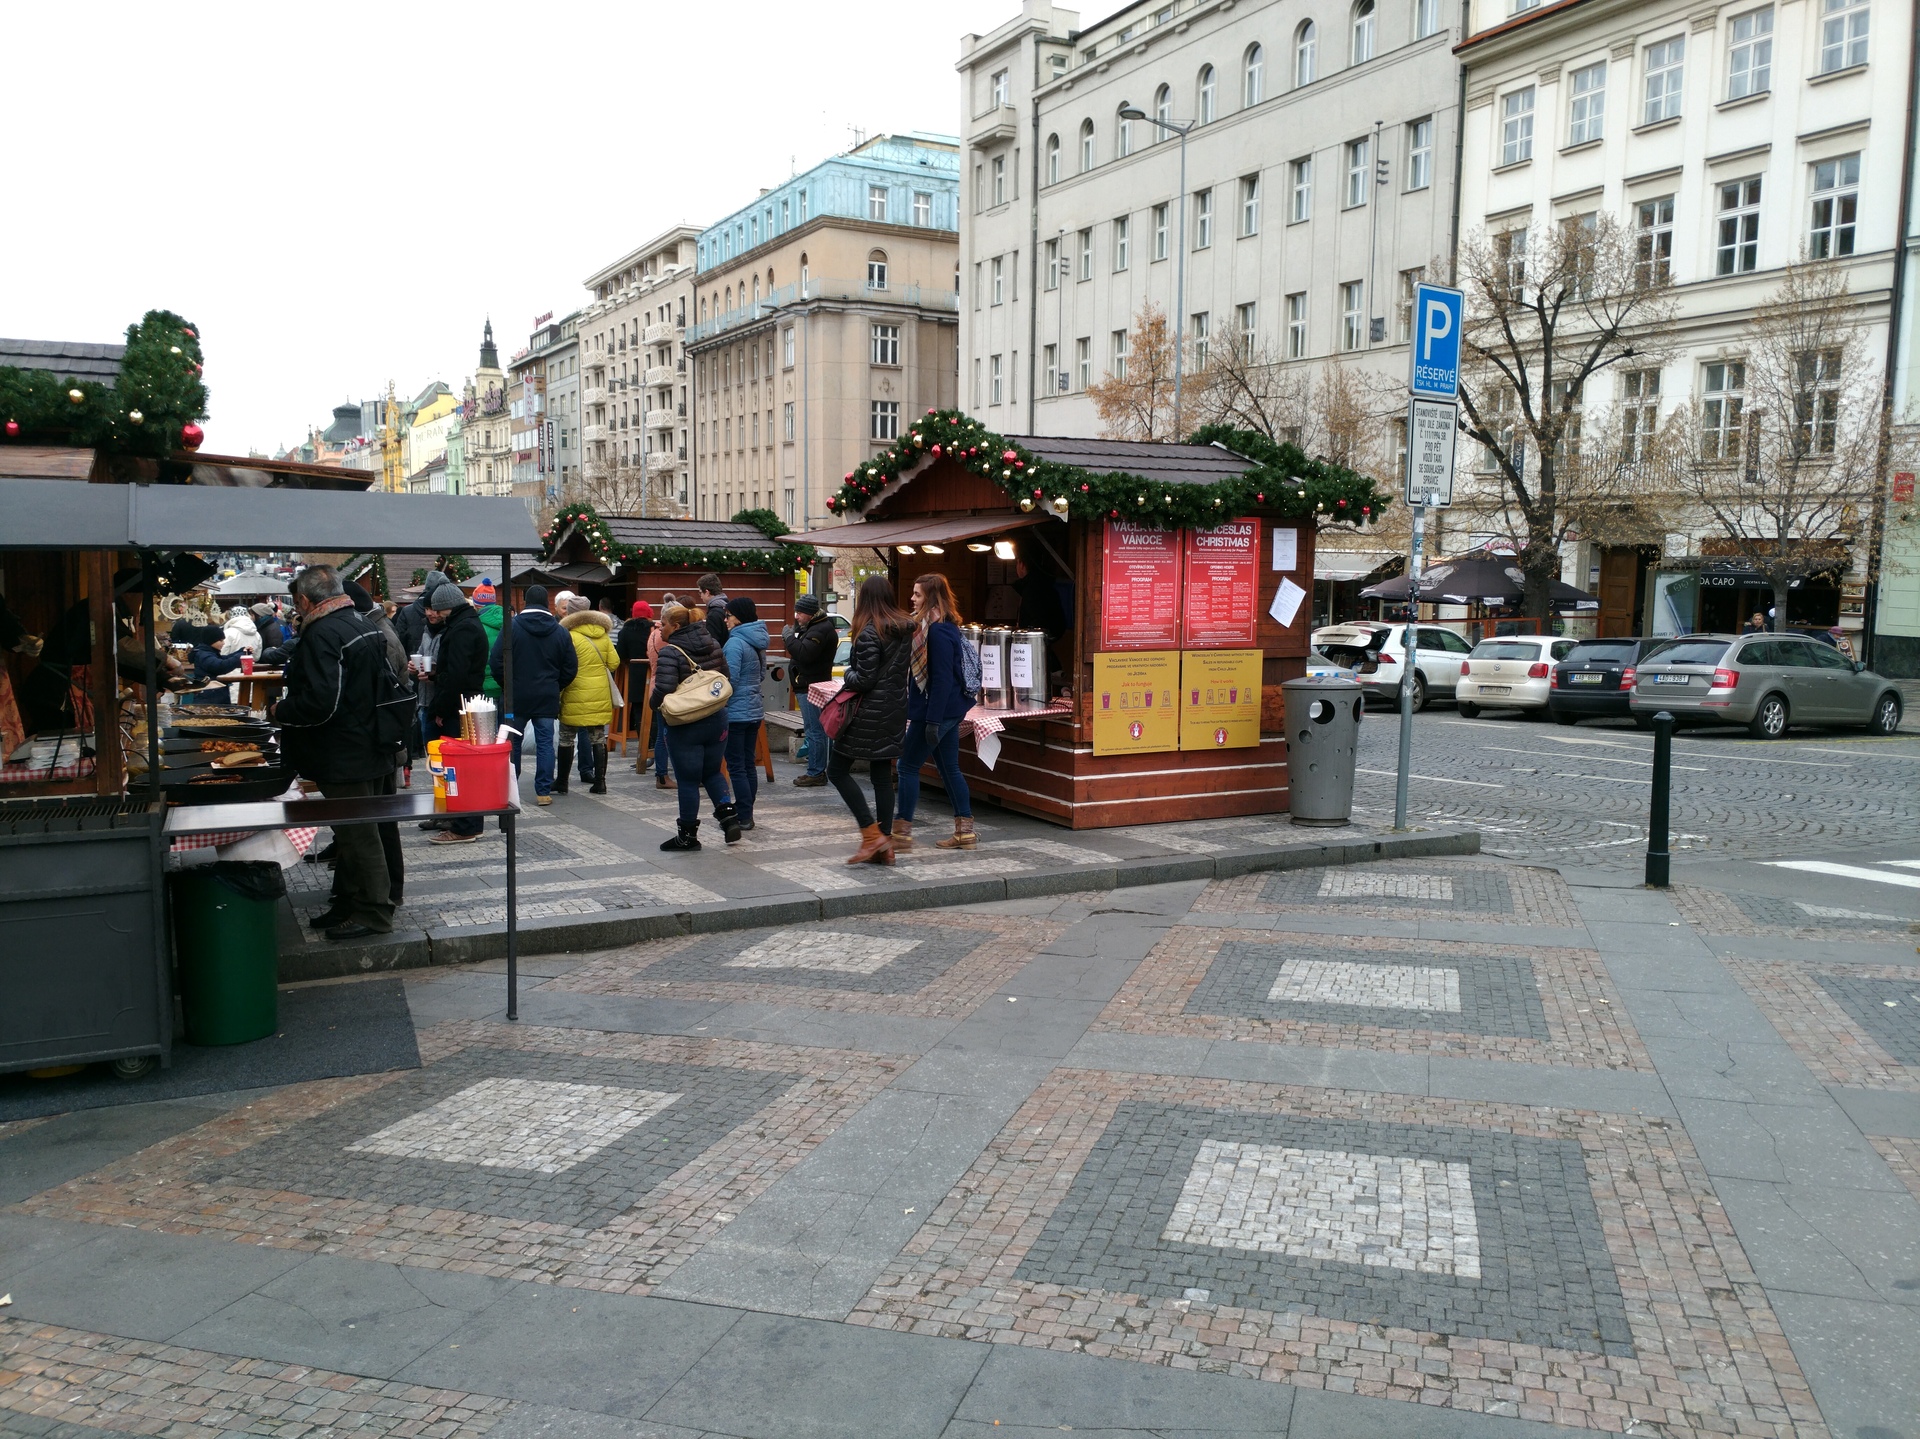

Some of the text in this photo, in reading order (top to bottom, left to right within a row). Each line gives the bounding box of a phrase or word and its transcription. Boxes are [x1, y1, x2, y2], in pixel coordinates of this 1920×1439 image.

[1424, 299, 1452, 360] P
[1416, 365, 1455, 383] RÉSERVÉ
[1440, 382, 1454, 391] PRAHY
[1418, 419, 1426, 427] TAXI
[1433, 453, 1443, 463] TAXI
[1412, 486, 1420, 495] AAA
[1122, 532, 1163, 545] VÁNOCE
[1196, 536, 1250, 547] CHRISTMAS
[1712, 577, 1735, 586] CAPO
